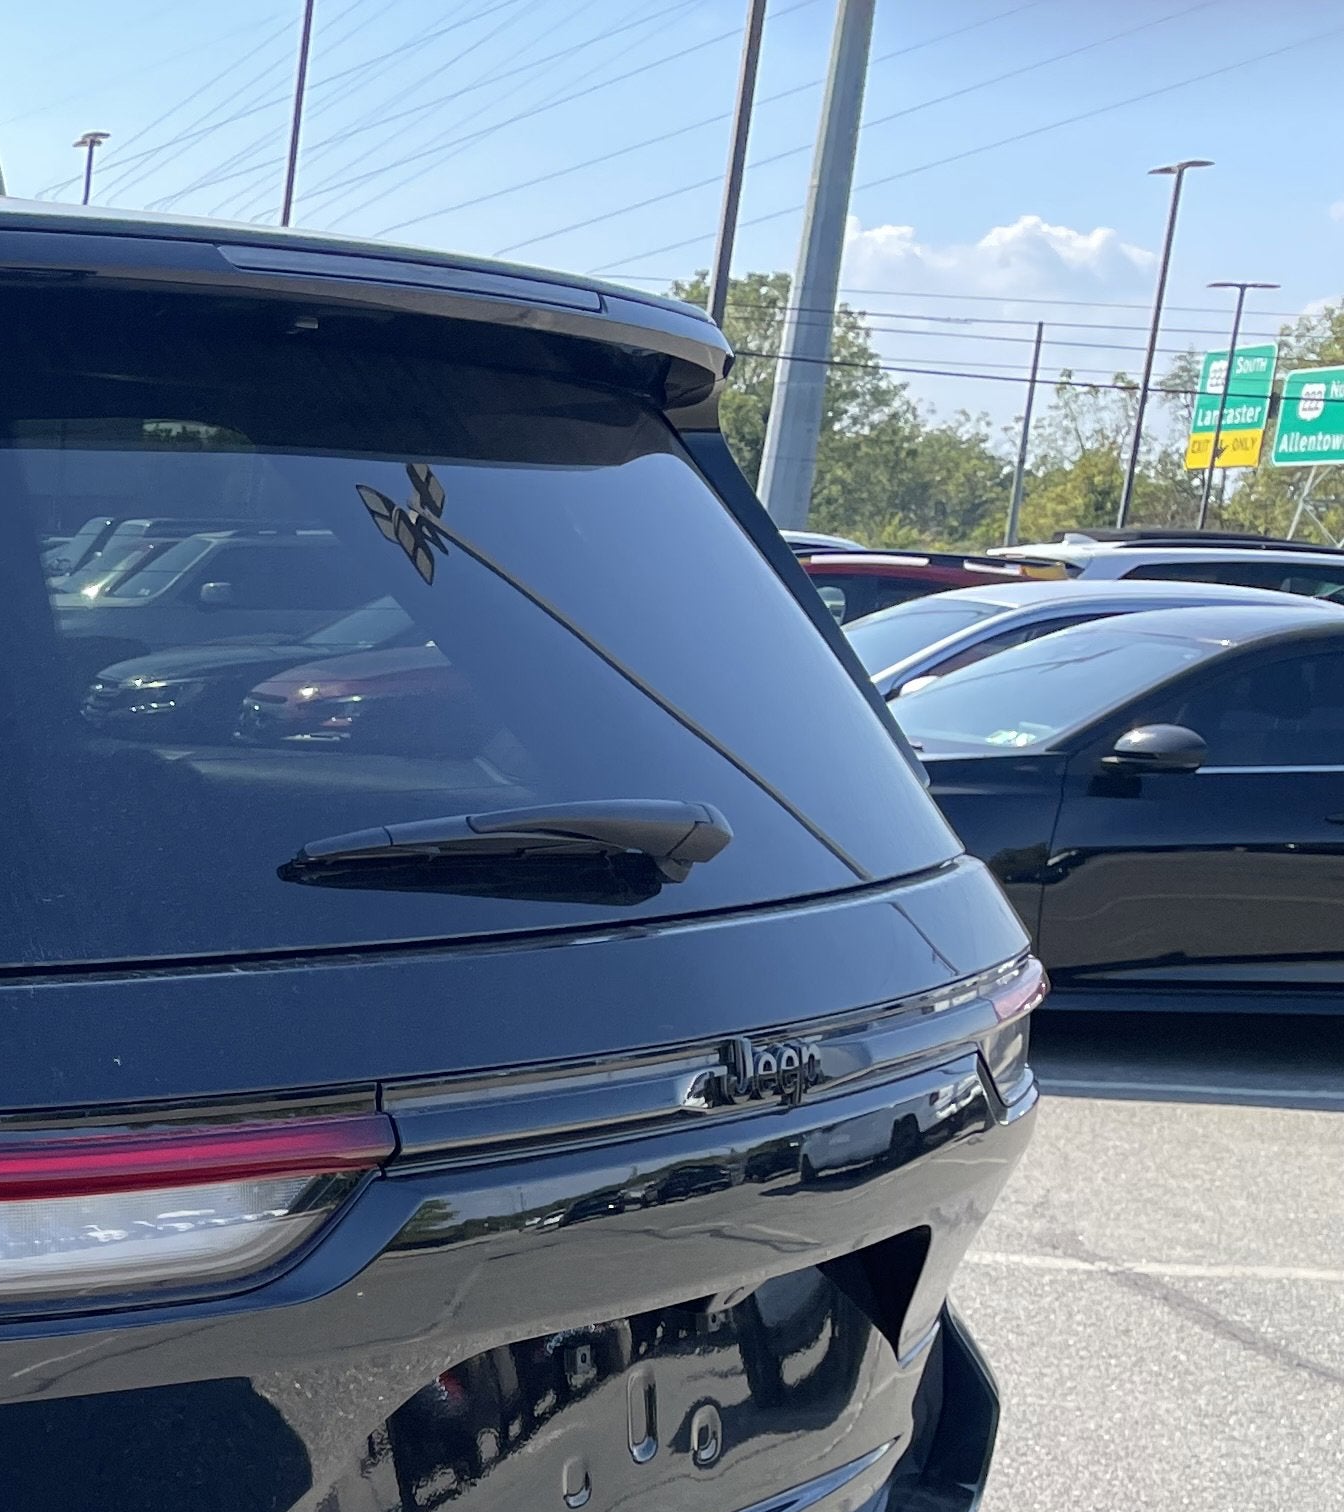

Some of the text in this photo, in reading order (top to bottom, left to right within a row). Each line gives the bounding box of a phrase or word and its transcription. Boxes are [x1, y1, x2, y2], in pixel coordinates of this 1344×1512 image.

[1232, 438, 1257, 452] ONLY
[1278, 431, 1344, 453] Allentow
[722, 1036, 823, 1104] Jeep
